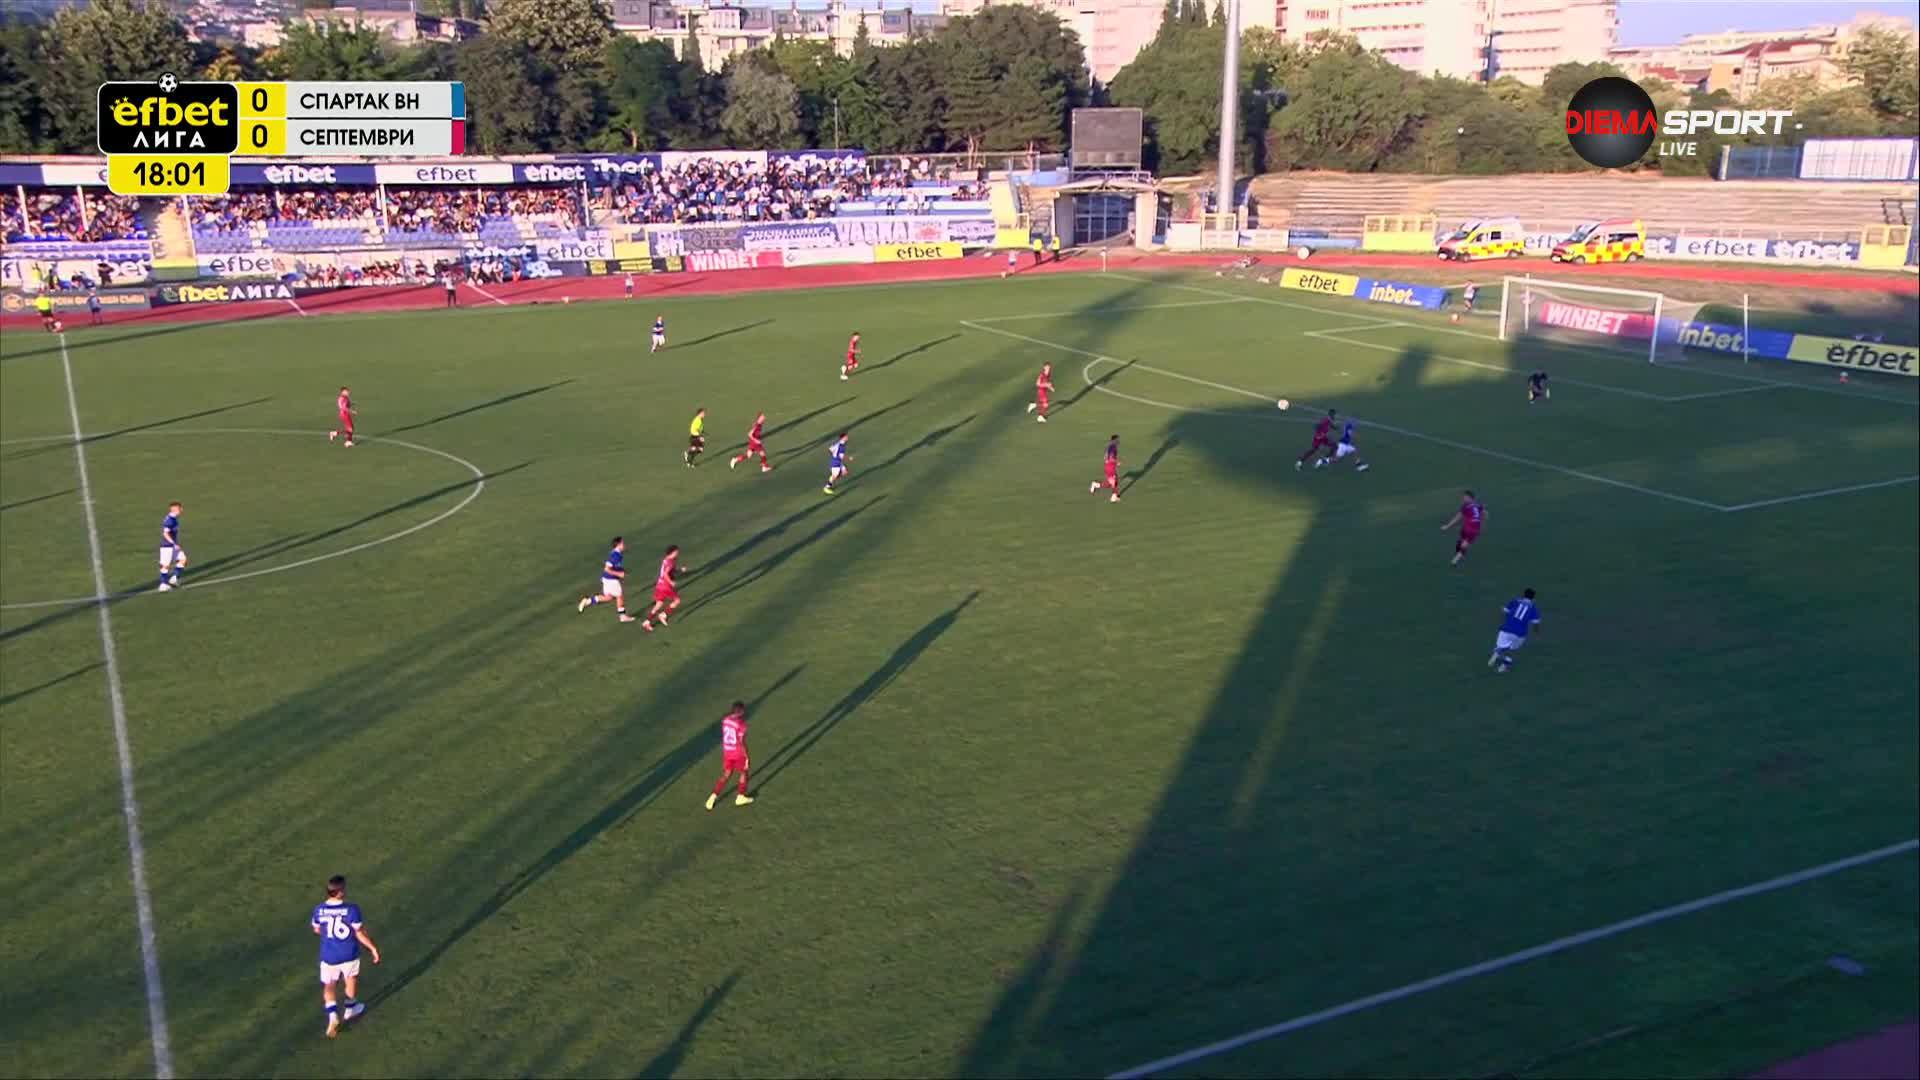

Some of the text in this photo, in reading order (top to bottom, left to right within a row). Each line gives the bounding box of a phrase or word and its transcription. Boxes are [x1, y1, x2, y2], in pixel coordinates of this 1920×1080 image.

[264, 165, 336, 185] efbet
[416, 166, 478, 182] efbet
[523, 164, 586, 182] efbet
[896, 245, 942, 260] efbet
[1687, 239, 1757, 257] efbet
[690, 251, 758, 272] WINBET
[231, 283, 293, 300] ЛИГА
[1298, 274, 1340, 293] efbet
[1546, 302, 1629, 335] WINBET
[1826, 343, 1917, 374] efbet
[1514, 604, 1529, 620] 11
[319, 916, 350, 940] 76
